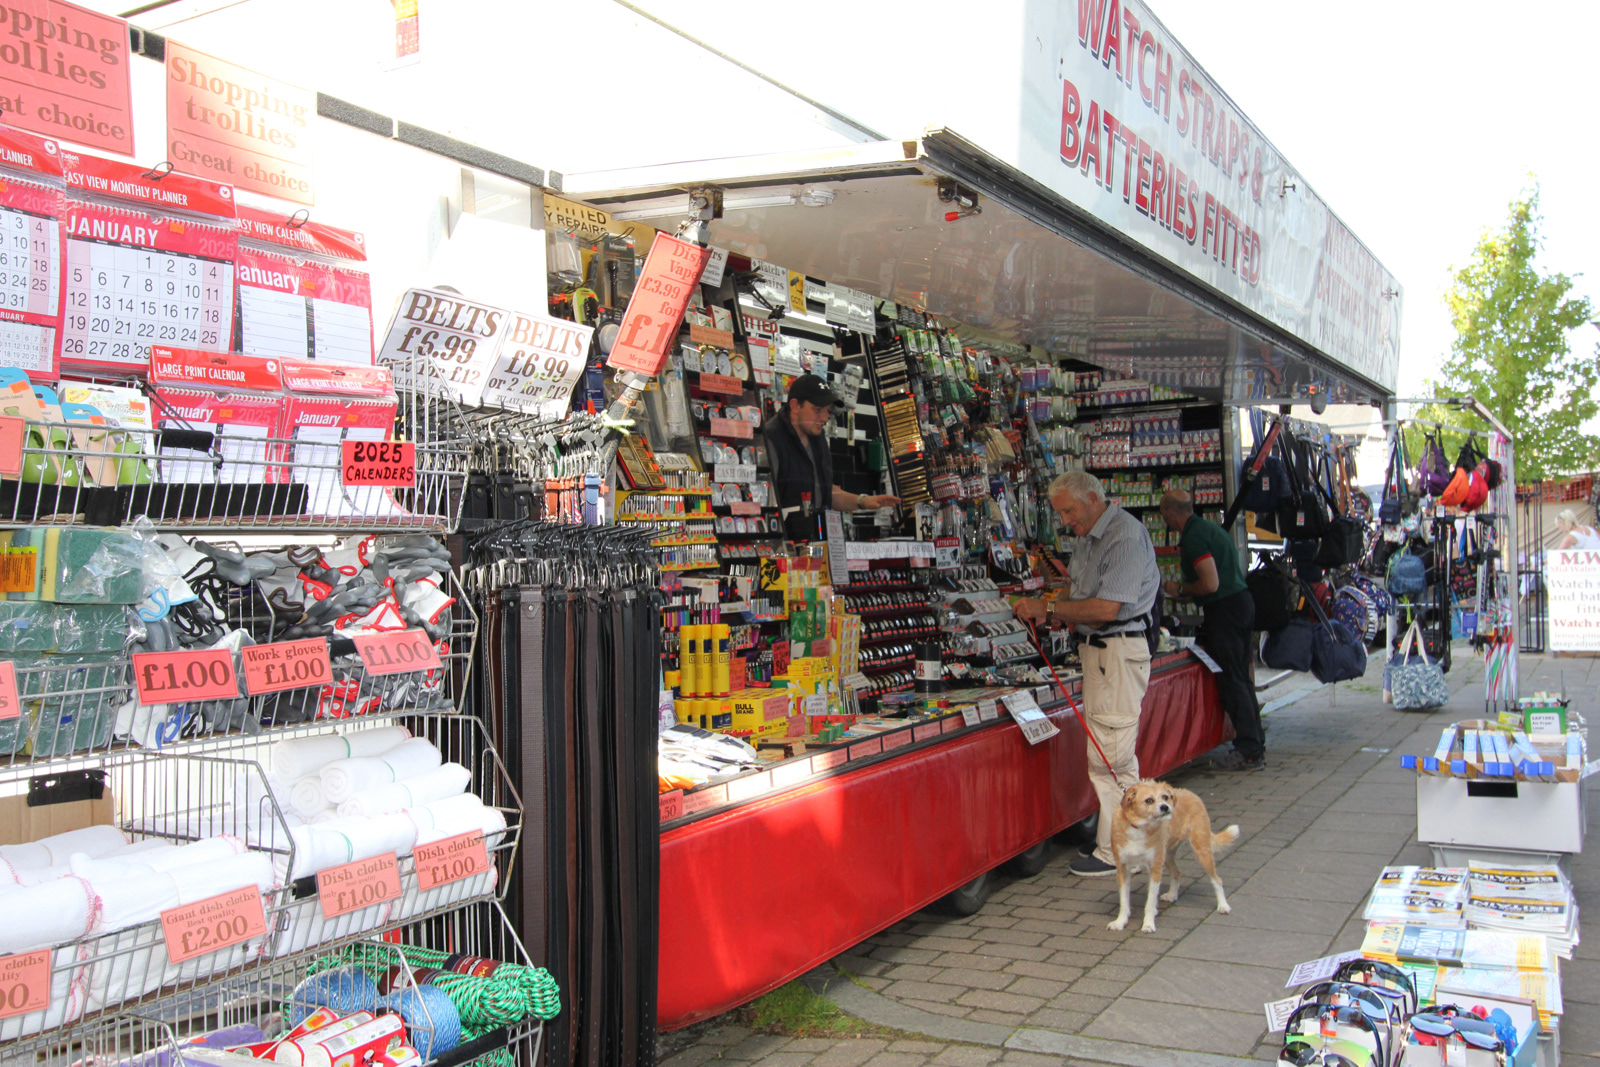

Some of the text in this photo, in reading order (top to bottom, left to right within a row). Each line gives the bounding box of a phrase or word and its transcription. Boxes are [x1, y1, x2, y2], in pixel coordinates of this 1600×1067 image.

[170, 55, 309, 127] Shopping
[1076, 0, 1264, 206] WATCH STRAPS &
[37, 103, 125, 140] choice
[185, 94, 297, 150] trollies
[171, 139, 310, 194] Great choice
[63, 170, 188, 206] EASY VIEW MONTHLY PLANNER
[1059, 78, 1262, 287] BATTERIES FITTED
[66, 215, 235, 261] JANUARY 2025
[237, 217, 315, 245] ASY VIEW CALENDAR
[166, 260, 175, 272] 2
[188, 263, 197, 276] 3
[209, 266, 217, 279] 4
[73, 268, 220, 302] 5 6 7 8 9 10 11
[236, 264, 370, 307] January 2025
[641, 277, 681, 300] £3.99
[69, 292, 220, 323] 12 13 14 15 16 17 18
[403, 291, 504, 338] BELTS
[658, 300, 680, 318] for
[68, 315, 218, 344] 19 20 21 22 23 24 25
[510, 316, 586, 358] BELTS
[64, 338, 84, 354] 26
[88, 341, 108, 356] 27
[112, 344, 130, 358] 28
[396, 326, 478, 364] £6.99
[158, 363, 183, 378] LARGE
[185, 366, 208, 380] PRINT
[208, 368, 246, 382] CALENDAR
[448, 368, 482, 386] £12
[504, 350, 570, 384] £6.99
[288, 376, 307, 387] LARGE
[488, 376, 506, 390] or
[506, 378, 519, 392] 2
[521, 380, 542, 397] for
[160, 401, 213, 423] January
[295, 410, 342, 428] January
[353, 442, 404, 464] 2025
[345, 465, 414, 482] CALENDERS
[1550, 592, 1576, 601] and
[1551, 578, 1593, 590] Watch
[1553, 618, 1594, 628] Watch
[247, 643, 324, 663] Work gloves
[364, 640, 432, 668] £1.00
[142, 660, 230, 692] £1.00
[264, 658, 324, 686] £1.00
[1024, 728, 1032, 740] 3
[1030, 727, 1040, 738] for
[660, 796, 676, 807] loves
[418, 835, 481, 862] Dish cloths
[322, 858, 394, 888] Dish cloths
[430, 856, 476, 886] £1.00
[166, 892, 256, 926] Giant dish cloths
[336, 880, 387, 912] £1.00
[186, 908, 236, 929] Best quality
[180, 915, 248, 955] £2.00
[5, 954, 45, 971] cloths
